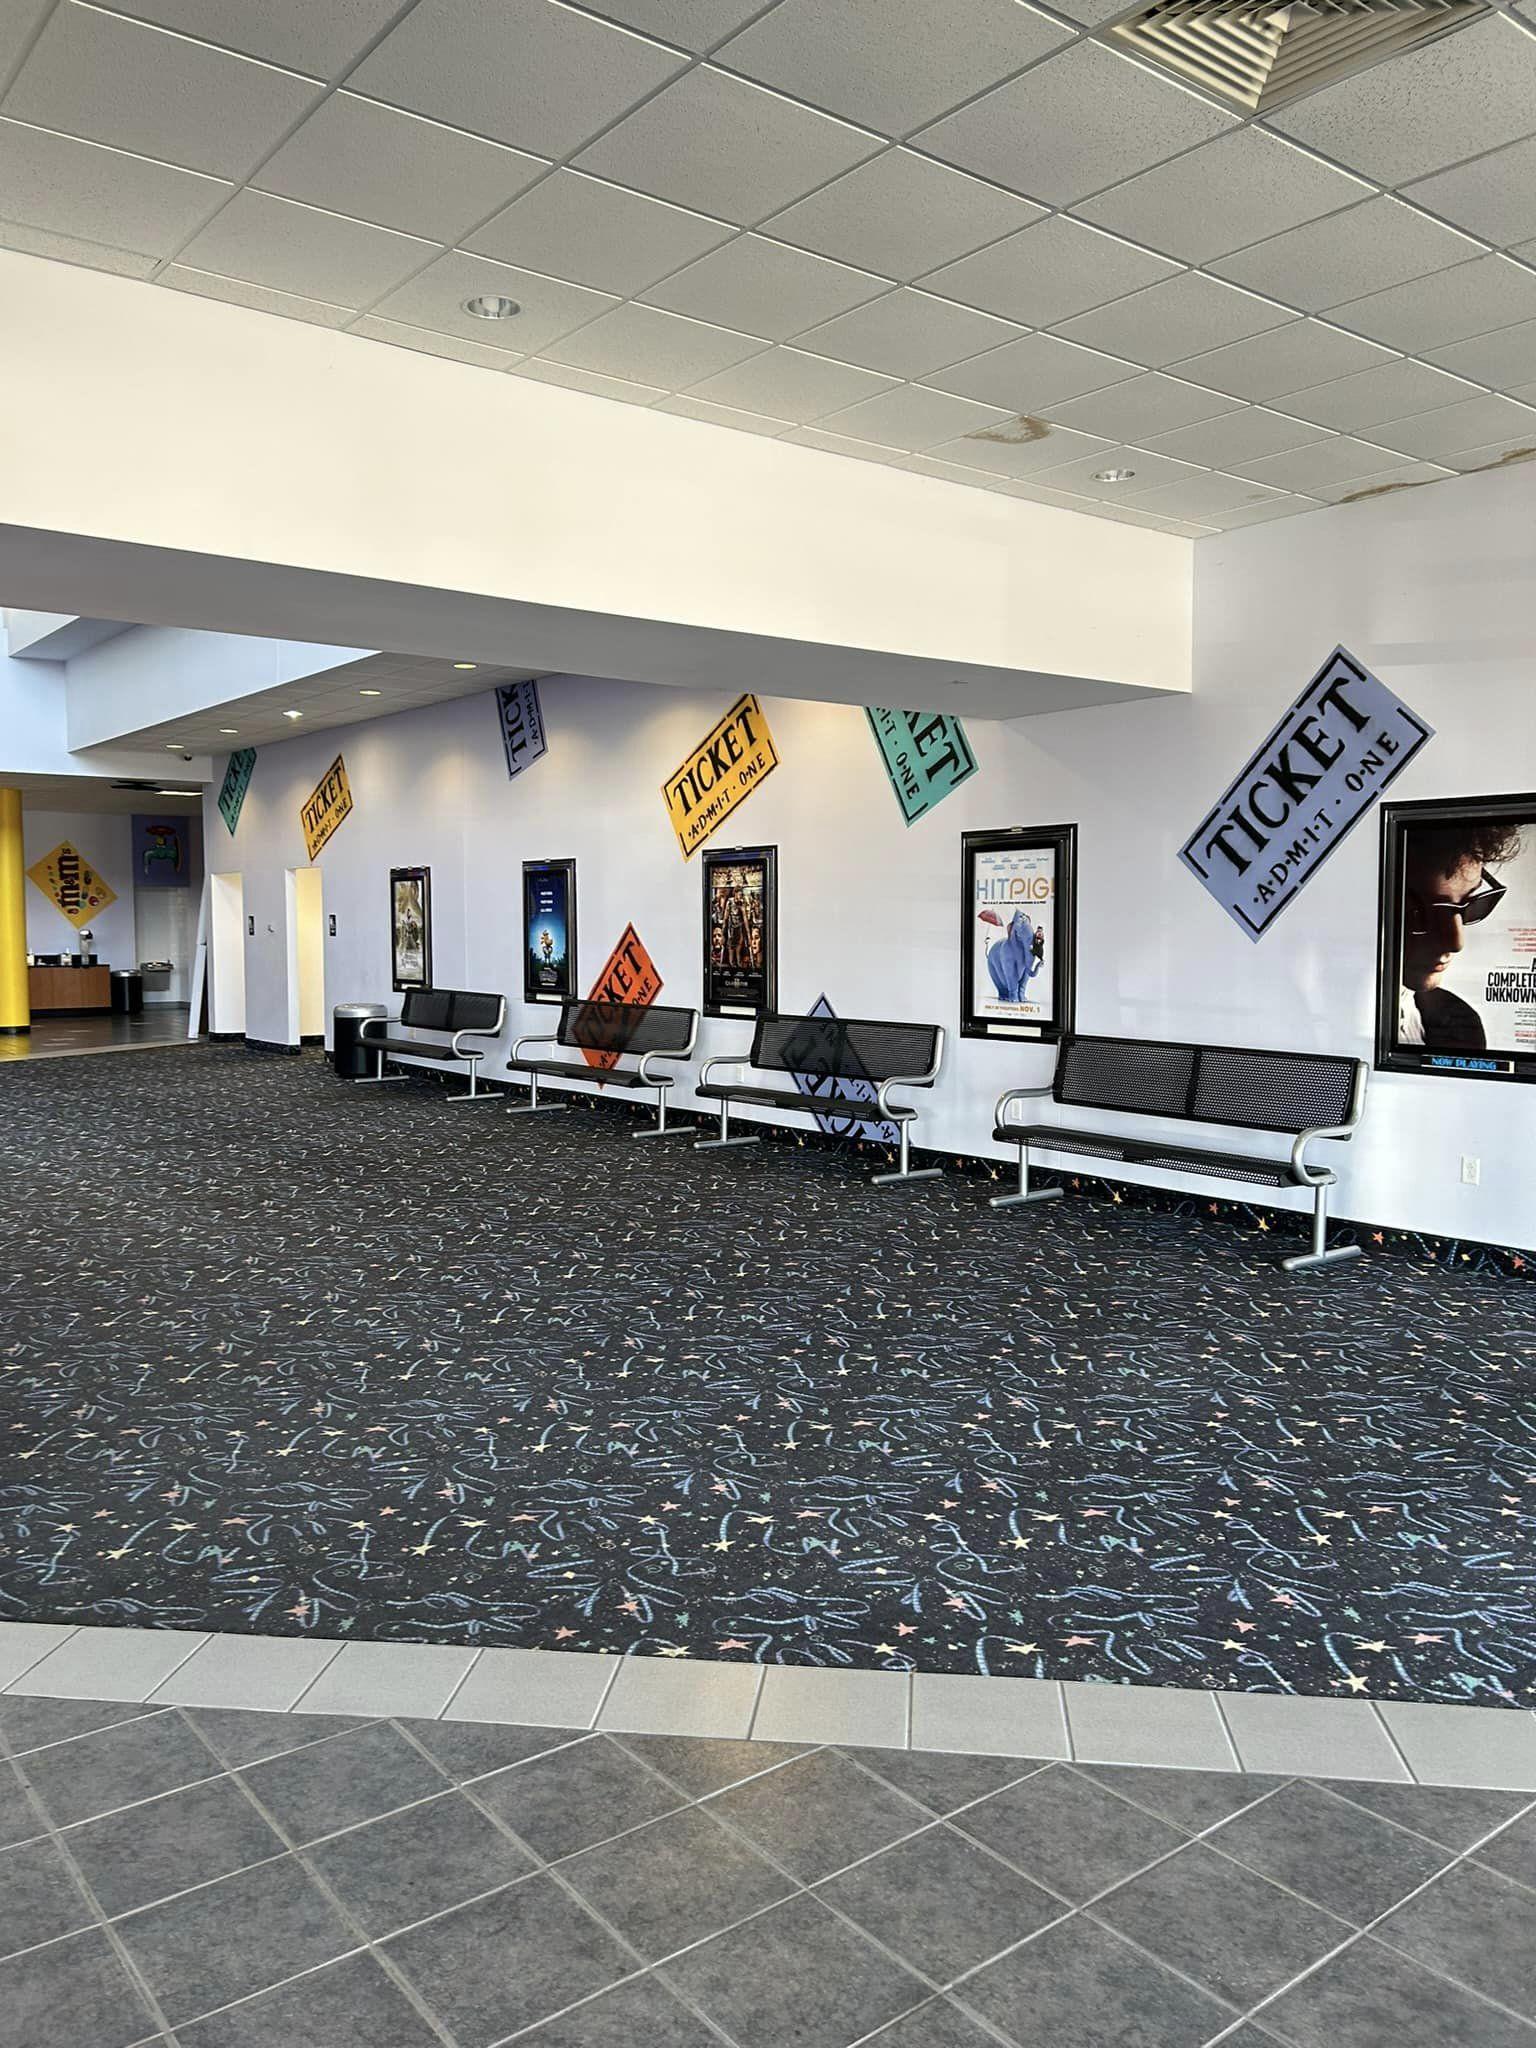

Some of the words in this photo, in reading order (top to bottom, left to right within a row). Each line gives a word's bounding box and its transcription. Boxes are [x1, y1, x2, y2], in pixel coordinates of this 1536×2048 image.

[673, 706, 757, 816] TICKET
[1206, 677, 1371, 877] TICKET
[305, 766, 344, 833] TICKET
[1485, 987, 1536, 1003] UNKNOWN
[1431, 1057, 1452, 1067] NOW
[1455, 1058, 1497, 1070] PLAYING
